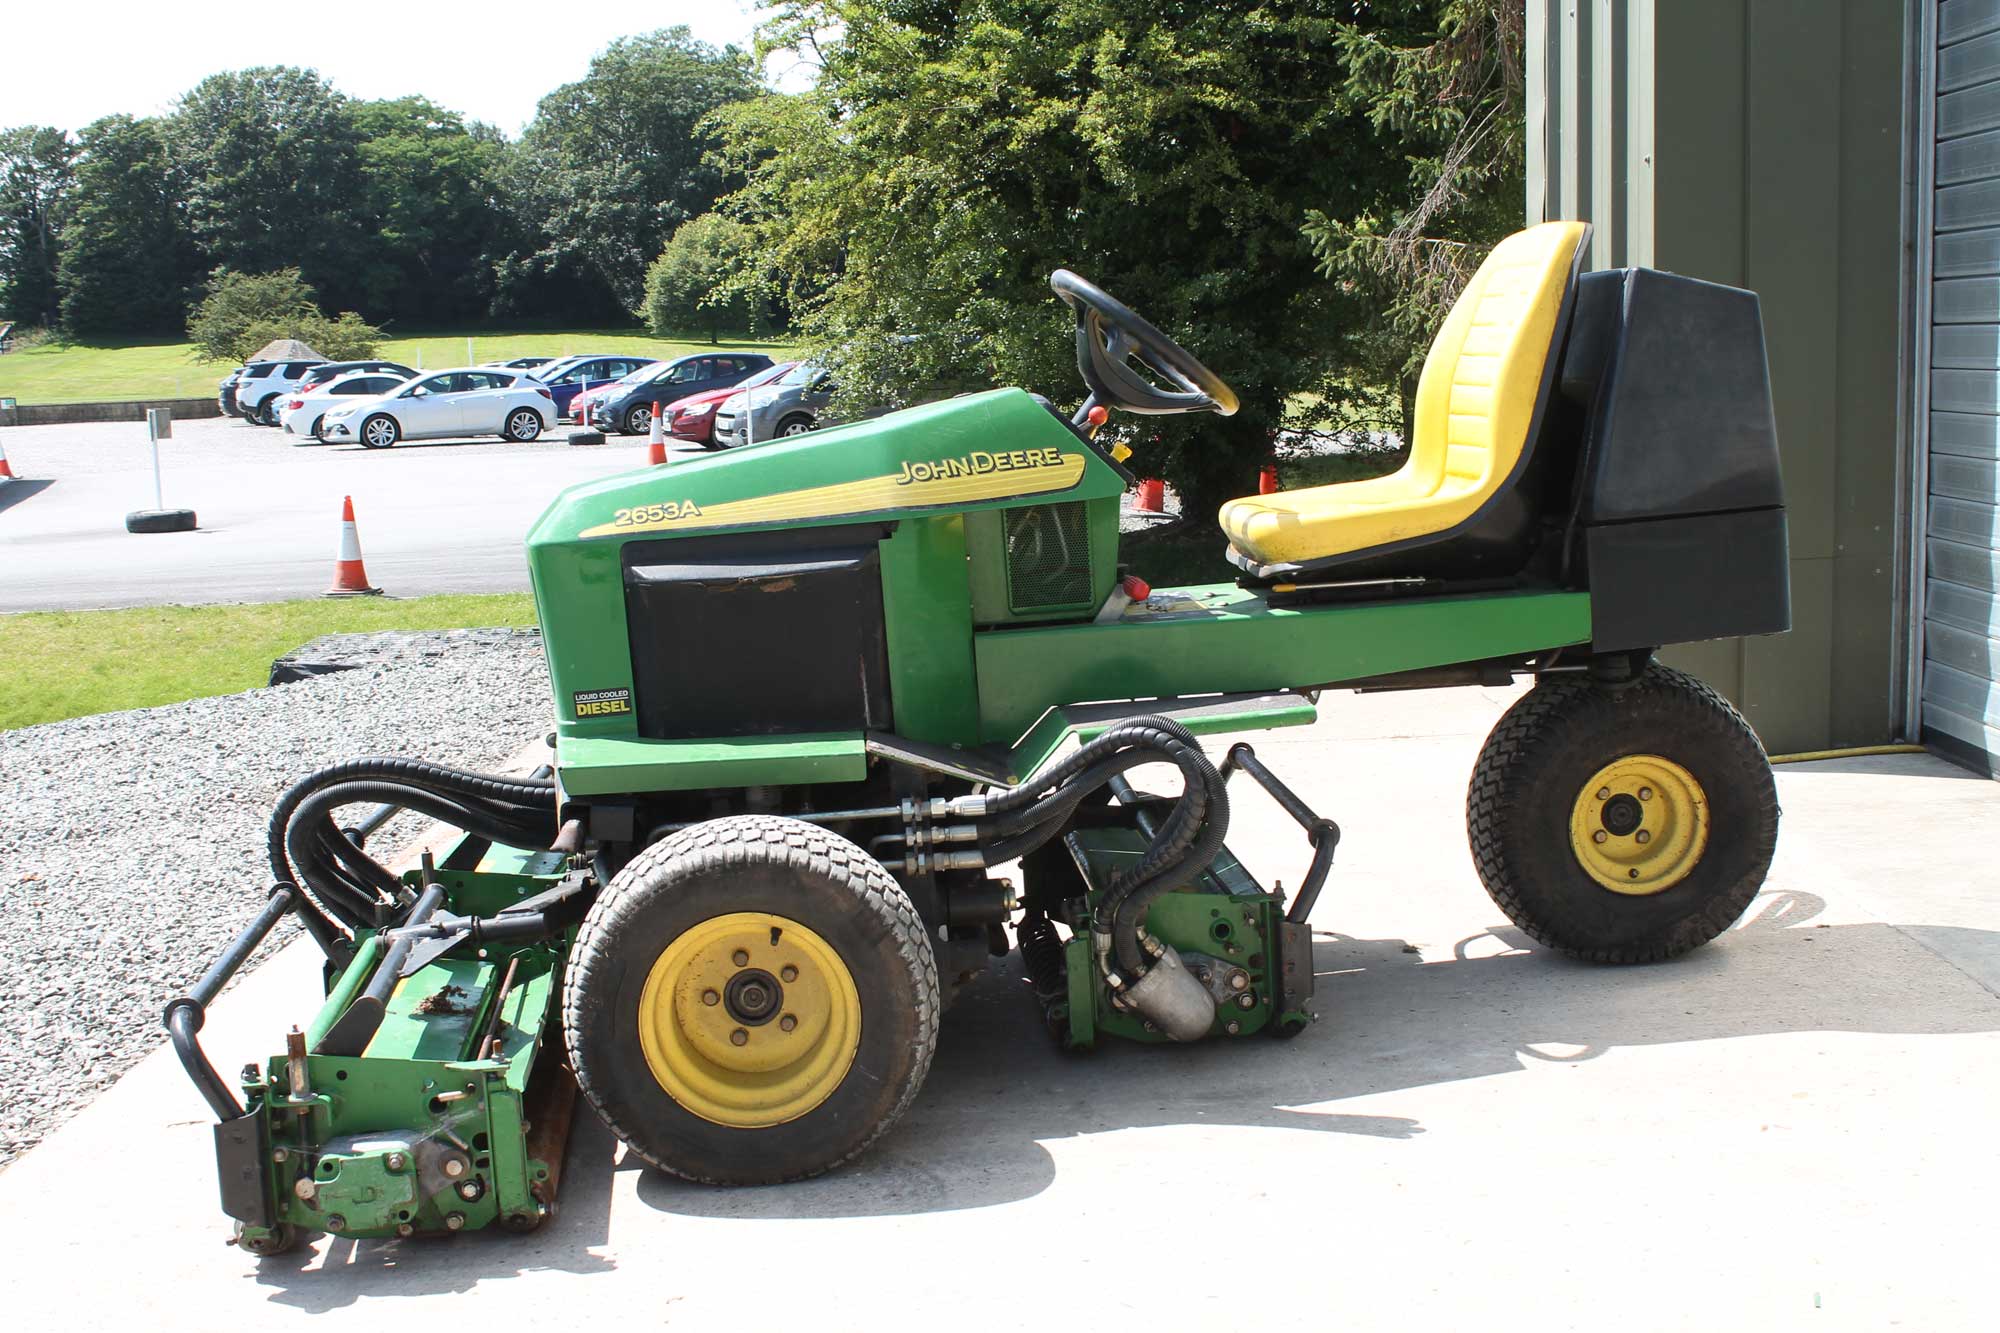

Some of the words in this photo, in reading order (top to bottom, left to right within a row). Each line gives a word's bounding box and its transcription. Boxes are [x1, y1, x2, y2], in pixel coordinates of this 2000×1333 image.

[896, 457, 972, 485] JOHN
[970, 447, 1064, 474] DEERE
[614, 499, 703, 527] 2653A
[575, 692, 598, 701] LIQUID
[599, 689, 629, 699] COOLED
[576, 699, 630, 716] DIESEL
